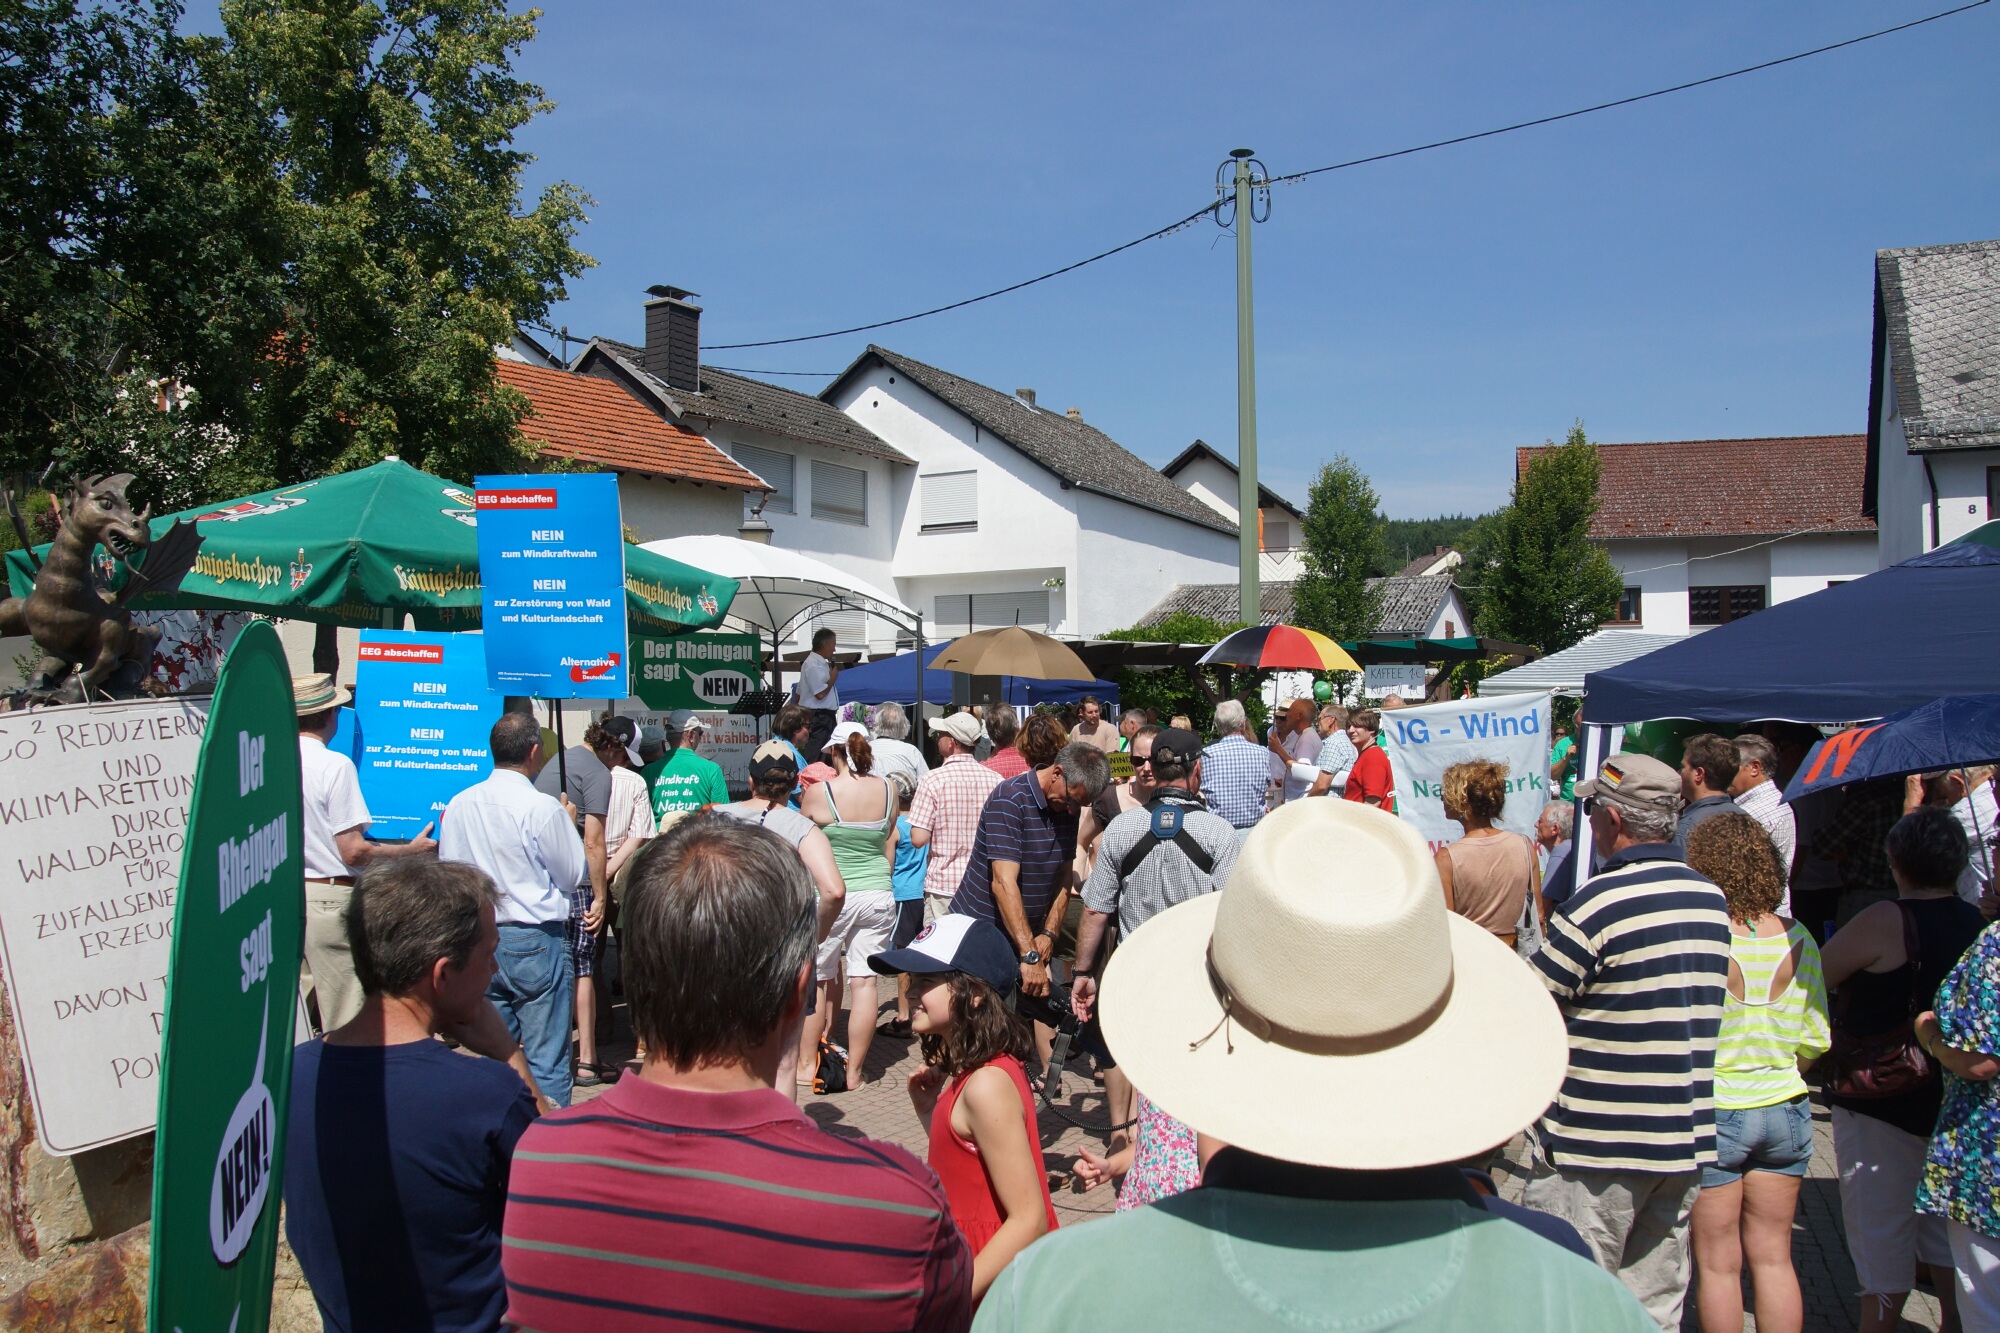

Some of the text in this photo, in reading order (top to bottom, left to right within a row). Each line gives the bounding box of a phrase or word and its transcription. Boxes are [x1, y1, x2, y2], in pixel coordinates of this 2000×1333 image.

[478, 494, 553, 504] EEG abschaffen
[1968, 504, 1977, 515] 8
[531, 530, 565, 541] NEIN
[523, 549, 598, 558] Windkraftwahn
[533, 579, 567, 590] NEIN
[510, 598, 564, 609] Zerstörung
[586, 599, 611, 607] Wald
[502, 614, 604, 623] und Kulturlandschaft
[360, 647, 439, 659] EEG abschaffen
[644, 640, 753, 662] Der Rheingau
[560, 656, 615, 667] Alternative
[643, 663, 680, 681] sagt
[413, 682, 447, 694] NEIN
[379, 699, 479, 711] zum Windkraftwahn
[637, 716, 658, 726] Wer
[1397, 719, 1430, 745] IG
[1459, 708, 1540, 740] Wind
[410, 728, 444, 739] NEIN
[365, 745, 381, 753] zur
[384, 745, 440, 757] Zerstörung
[462, 748, 487, 758] Wald
[103, 754, 162, 782] UND
[238, 730, 265, 798] Der
[373, 760, 478, 771] und Kulturlandschaft
[655, 774, 700, 787] Windkraft
[657, 799, 700, 813] Natur
[18, 833, 184, 884] WALDABHO
[218, 811, 288, 915] Rheingau
[123, 858, 178, 888] FÜR
[32, 887, 178, 940] ZUFALLSENE
[240, 908, 274, 994] sagt
[54, 981, 148, 1021] DAVON
[220, 1096, 270, 1246] NEIN!
